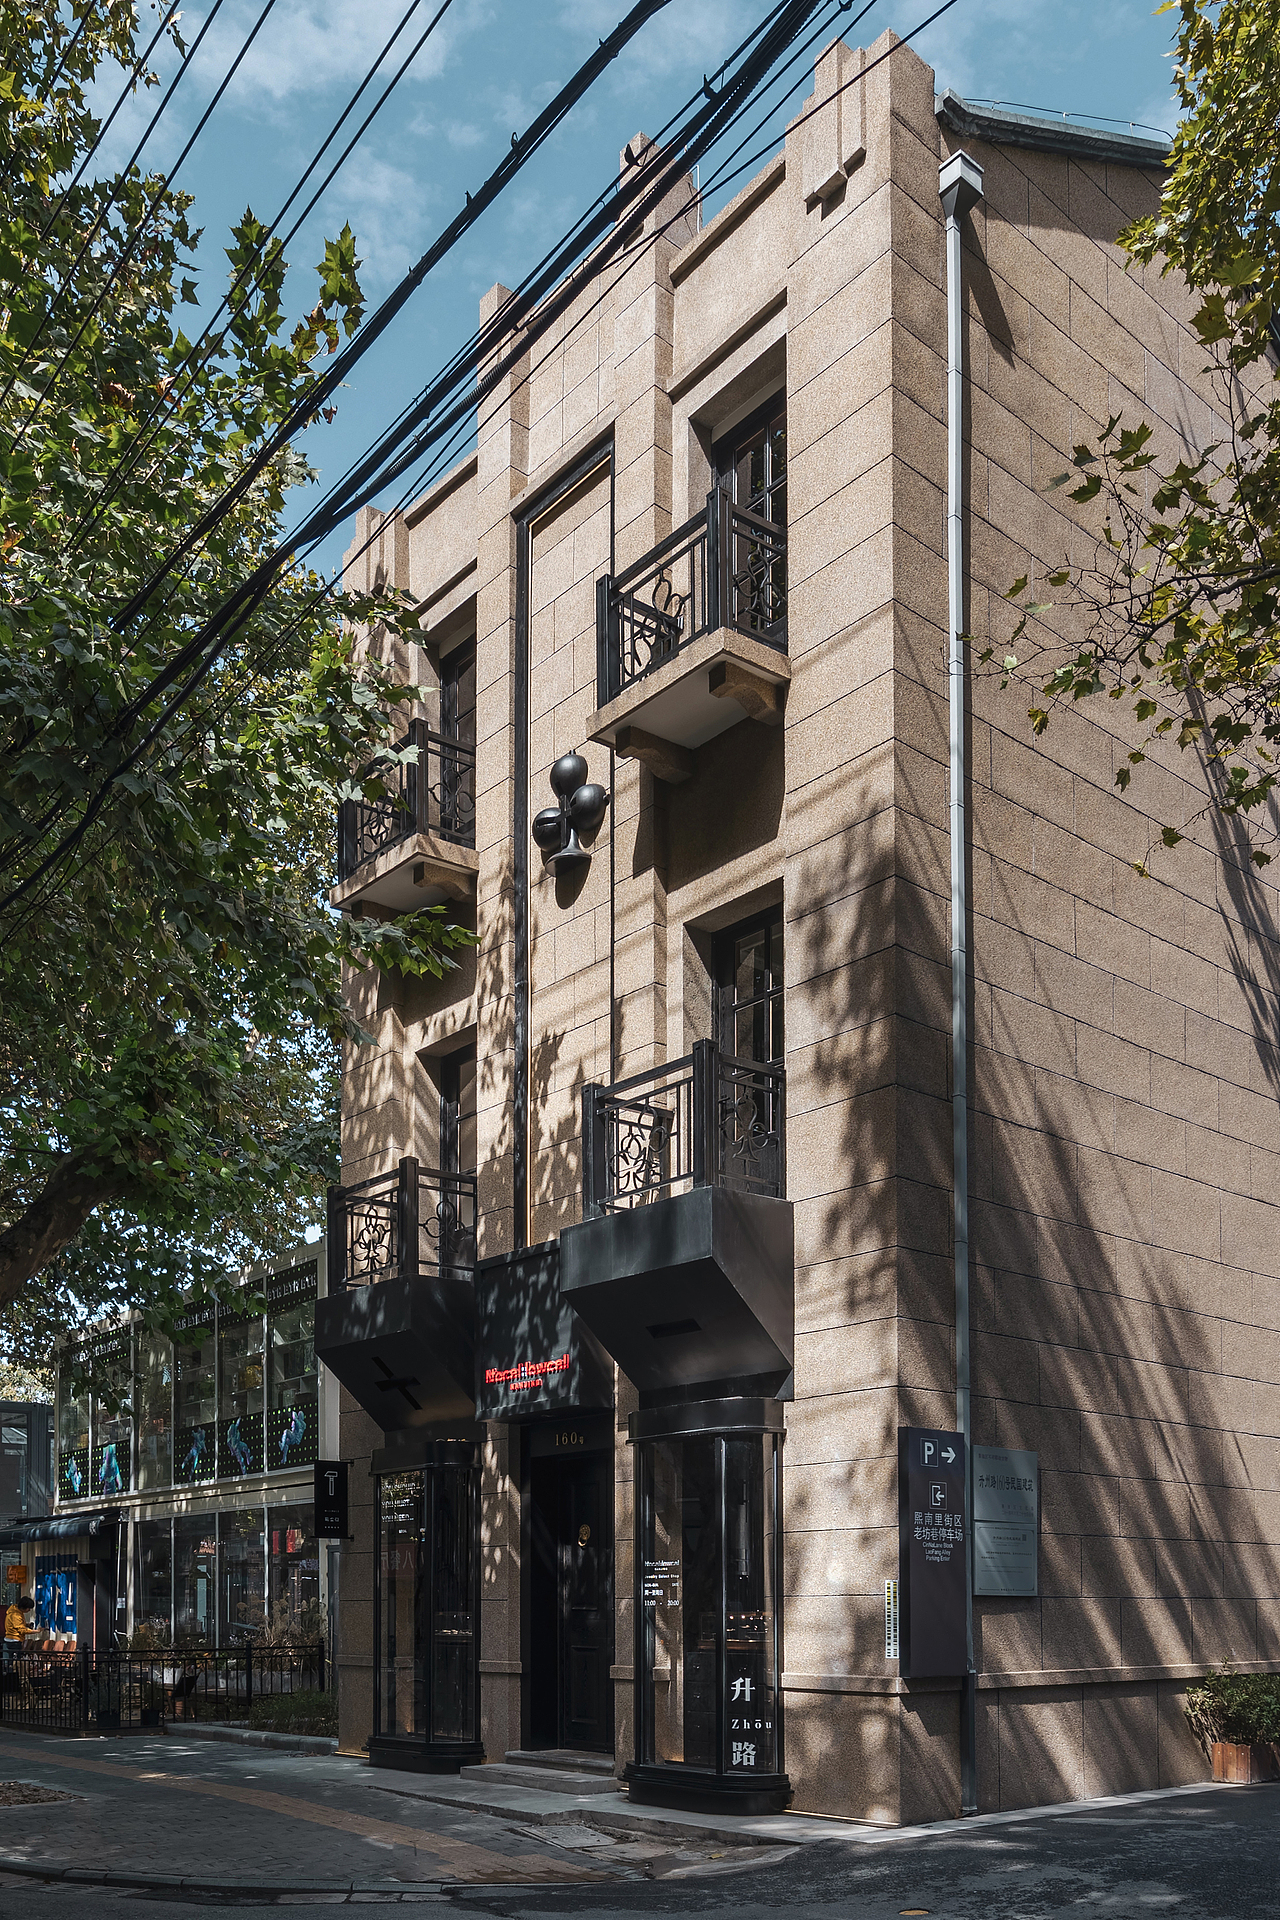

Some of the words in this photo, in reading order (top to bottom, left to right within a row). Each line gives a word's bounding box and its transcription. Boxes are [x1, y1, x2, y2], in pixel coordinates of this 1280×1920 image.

[914, 1511, 963, 1528] 熙南里街区
[913, 1526, 964, 1542] 老坊巷停车场
[730, 1676, 756, 1702] 升
[731, 1718, 773, 1730] Zhōu
[732, 1740, 756, 1767] 路
